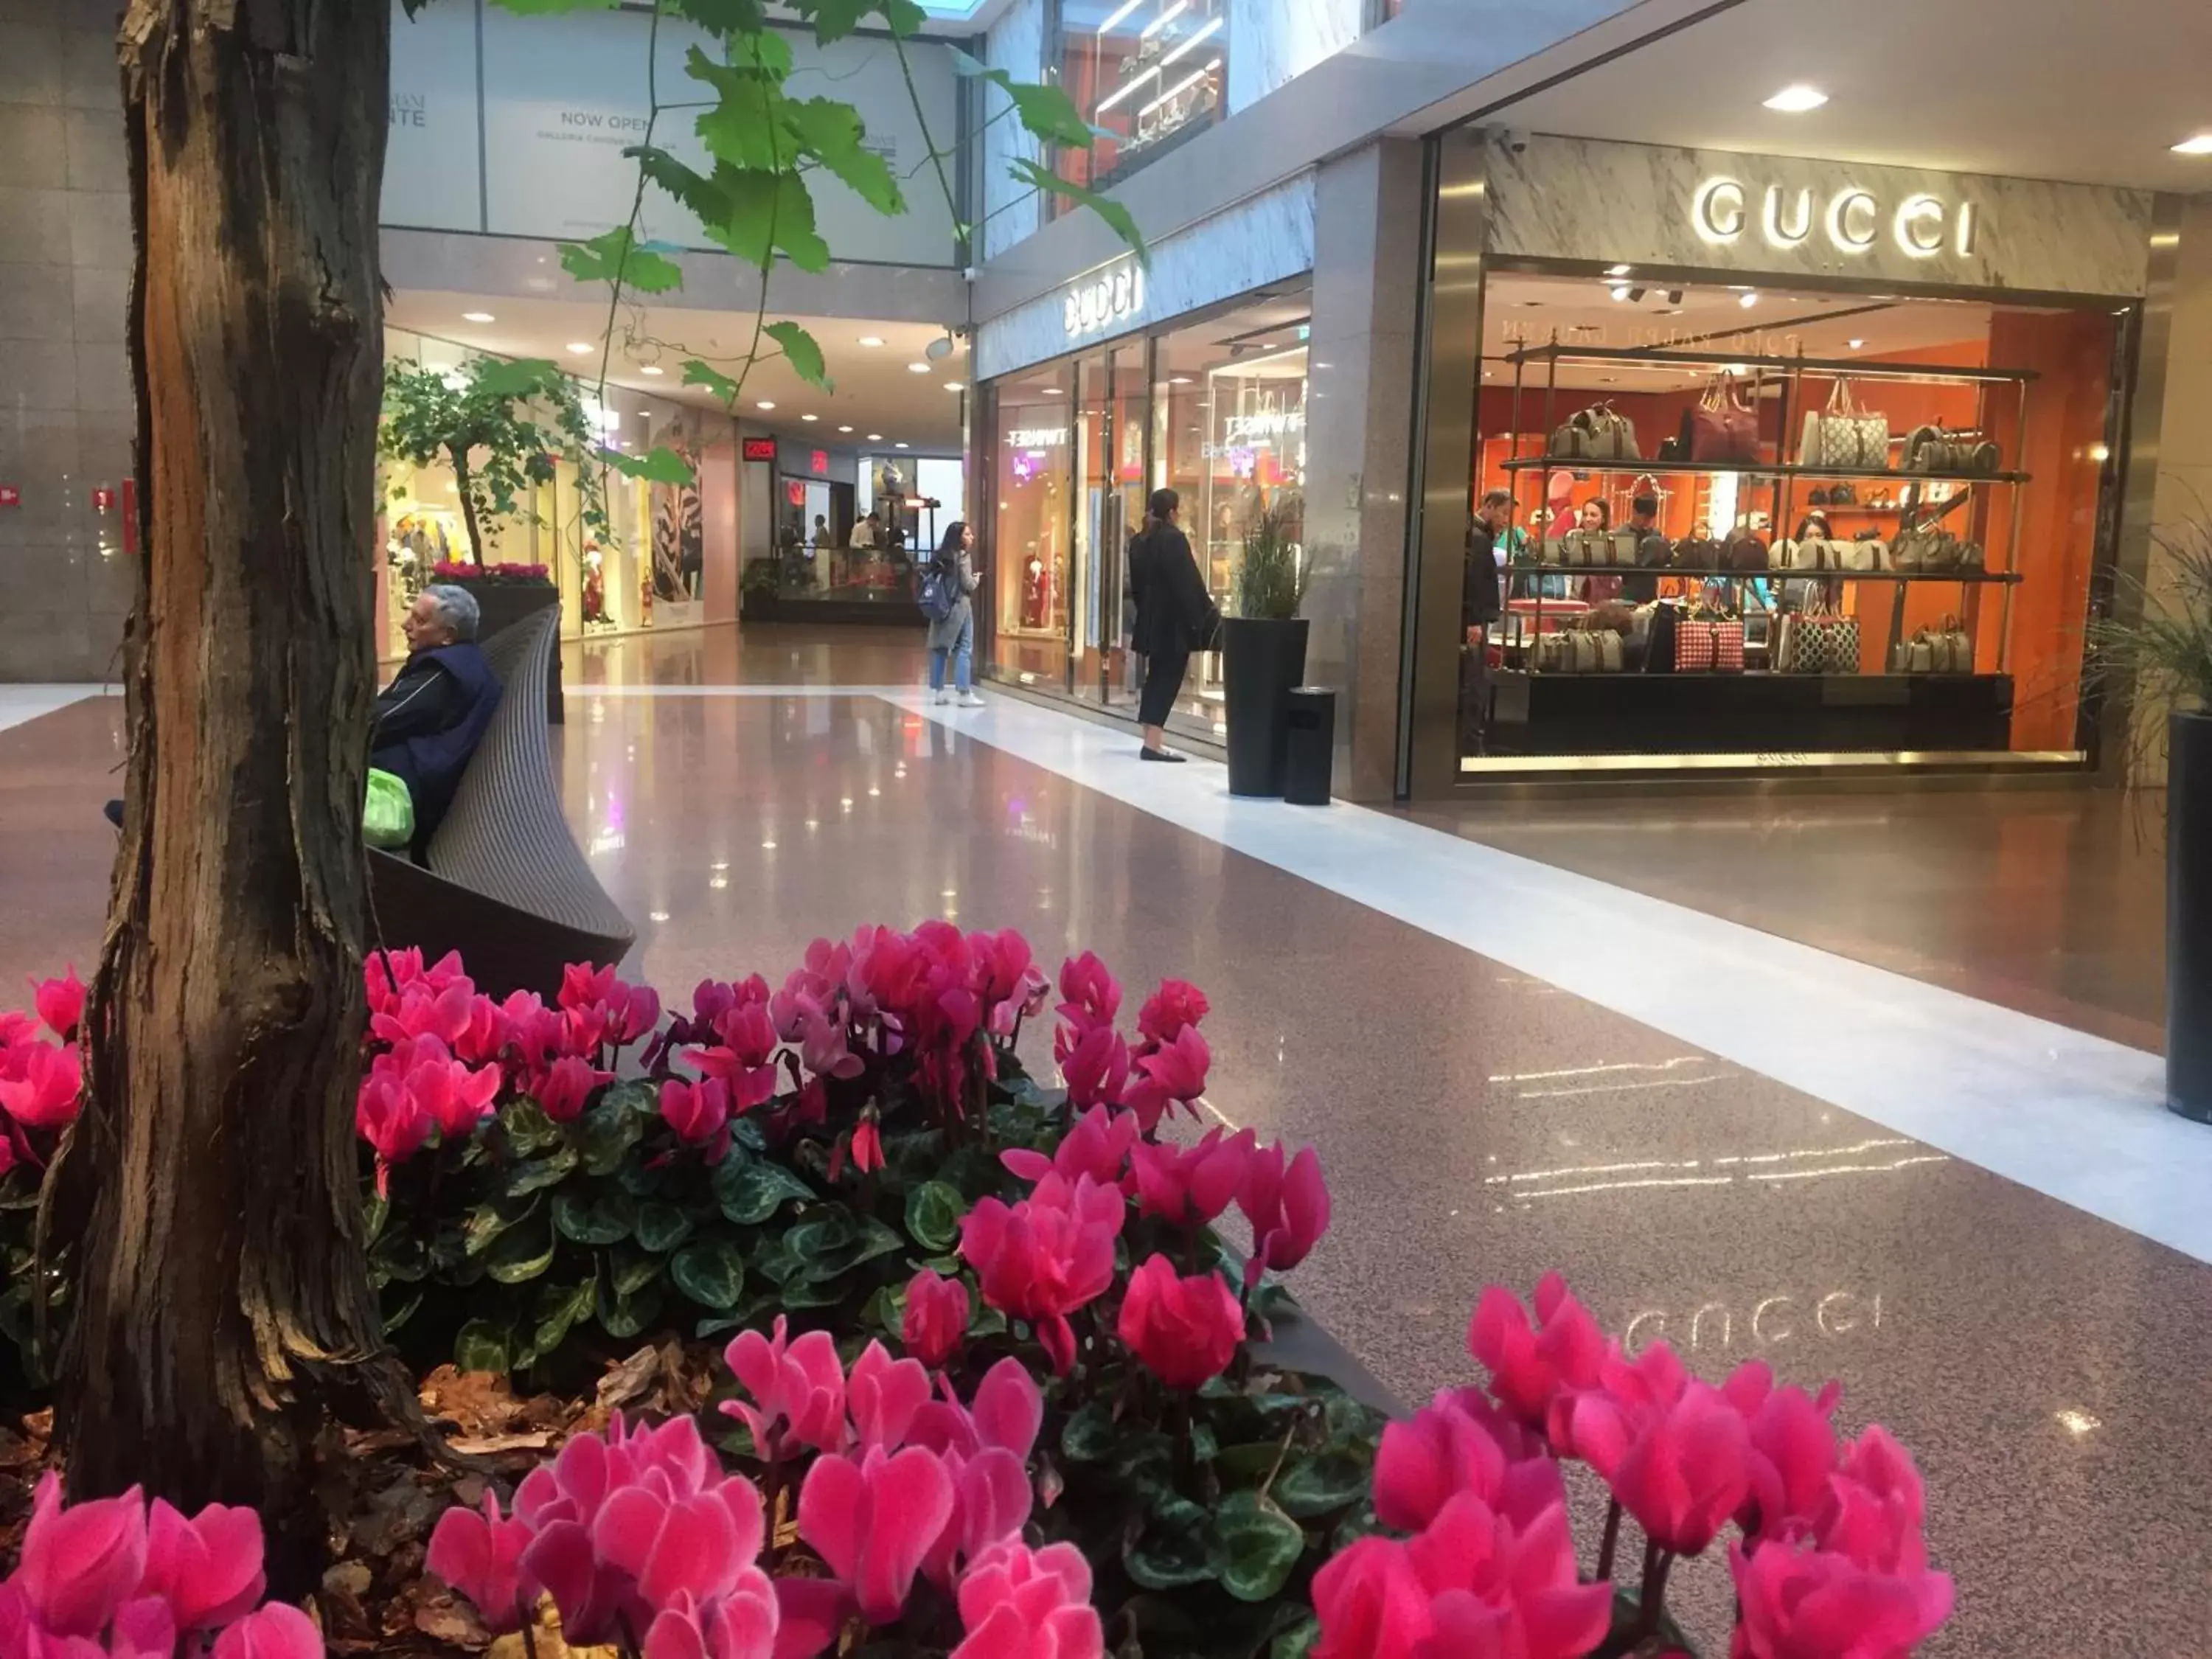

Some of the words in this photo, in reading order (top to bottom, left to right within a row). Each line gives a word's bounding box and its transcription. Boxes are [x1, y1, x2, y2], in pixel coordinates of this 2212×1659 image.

[561, 111, 602, 128] NOW
[1694, 177, 1979, 257] GUCCI
[1064, 257, 1143, 336] GUCCI
